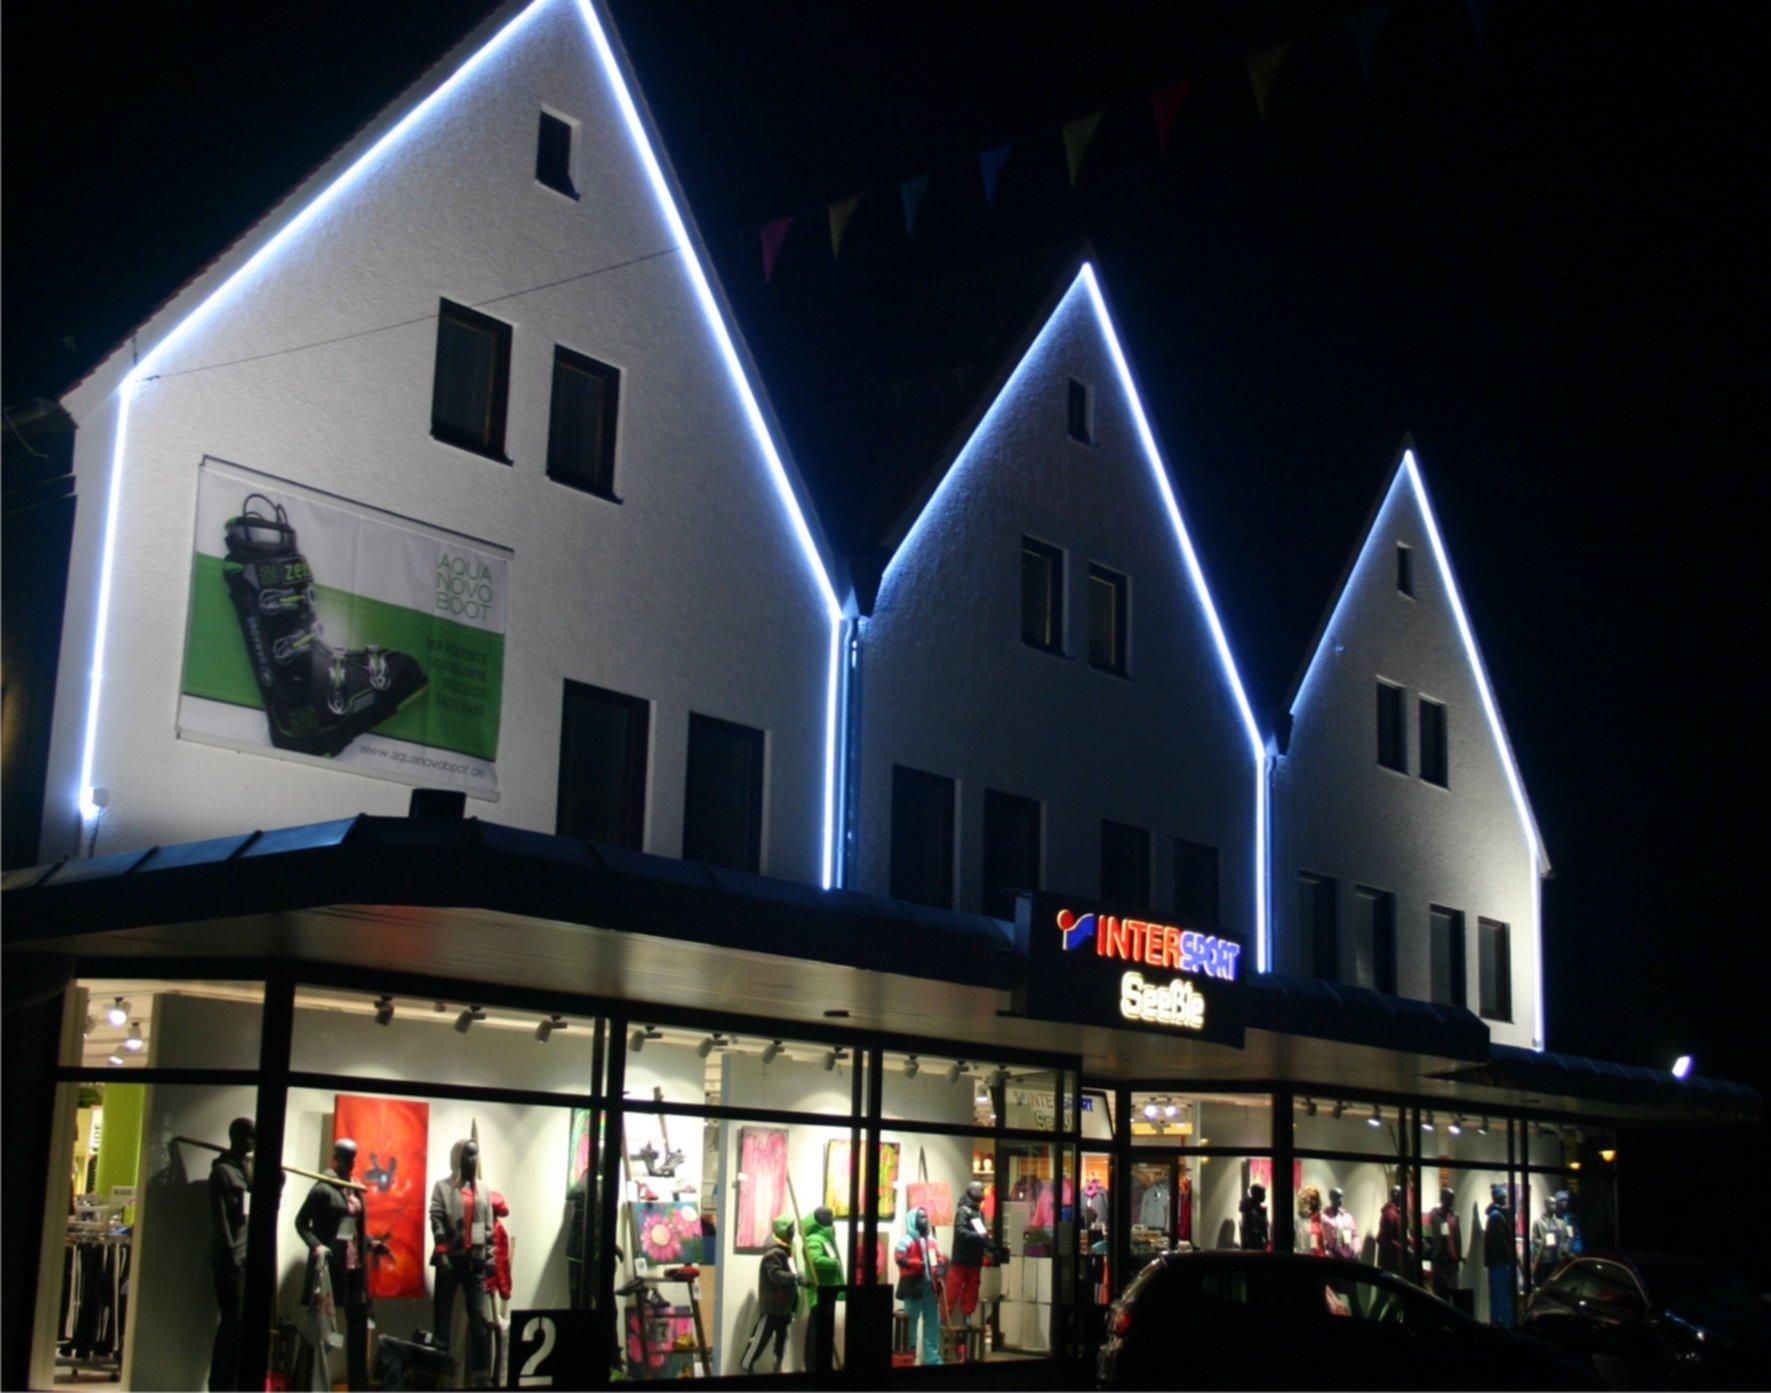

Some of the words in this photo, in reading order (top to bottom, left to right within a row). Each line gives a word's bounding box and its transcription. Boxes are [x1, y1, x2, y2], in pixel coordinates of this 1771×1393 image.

[437, 572, 492, 603] NOVO
[438, 554, 492, 584] AQUA
[437, 591, 491, 622] BOOT
[1097, 915, 1240, 981] INTERSPORT
[1121, 971, 1205, 1030] Seeßle
[518, 1316, 556, 1388] 2
